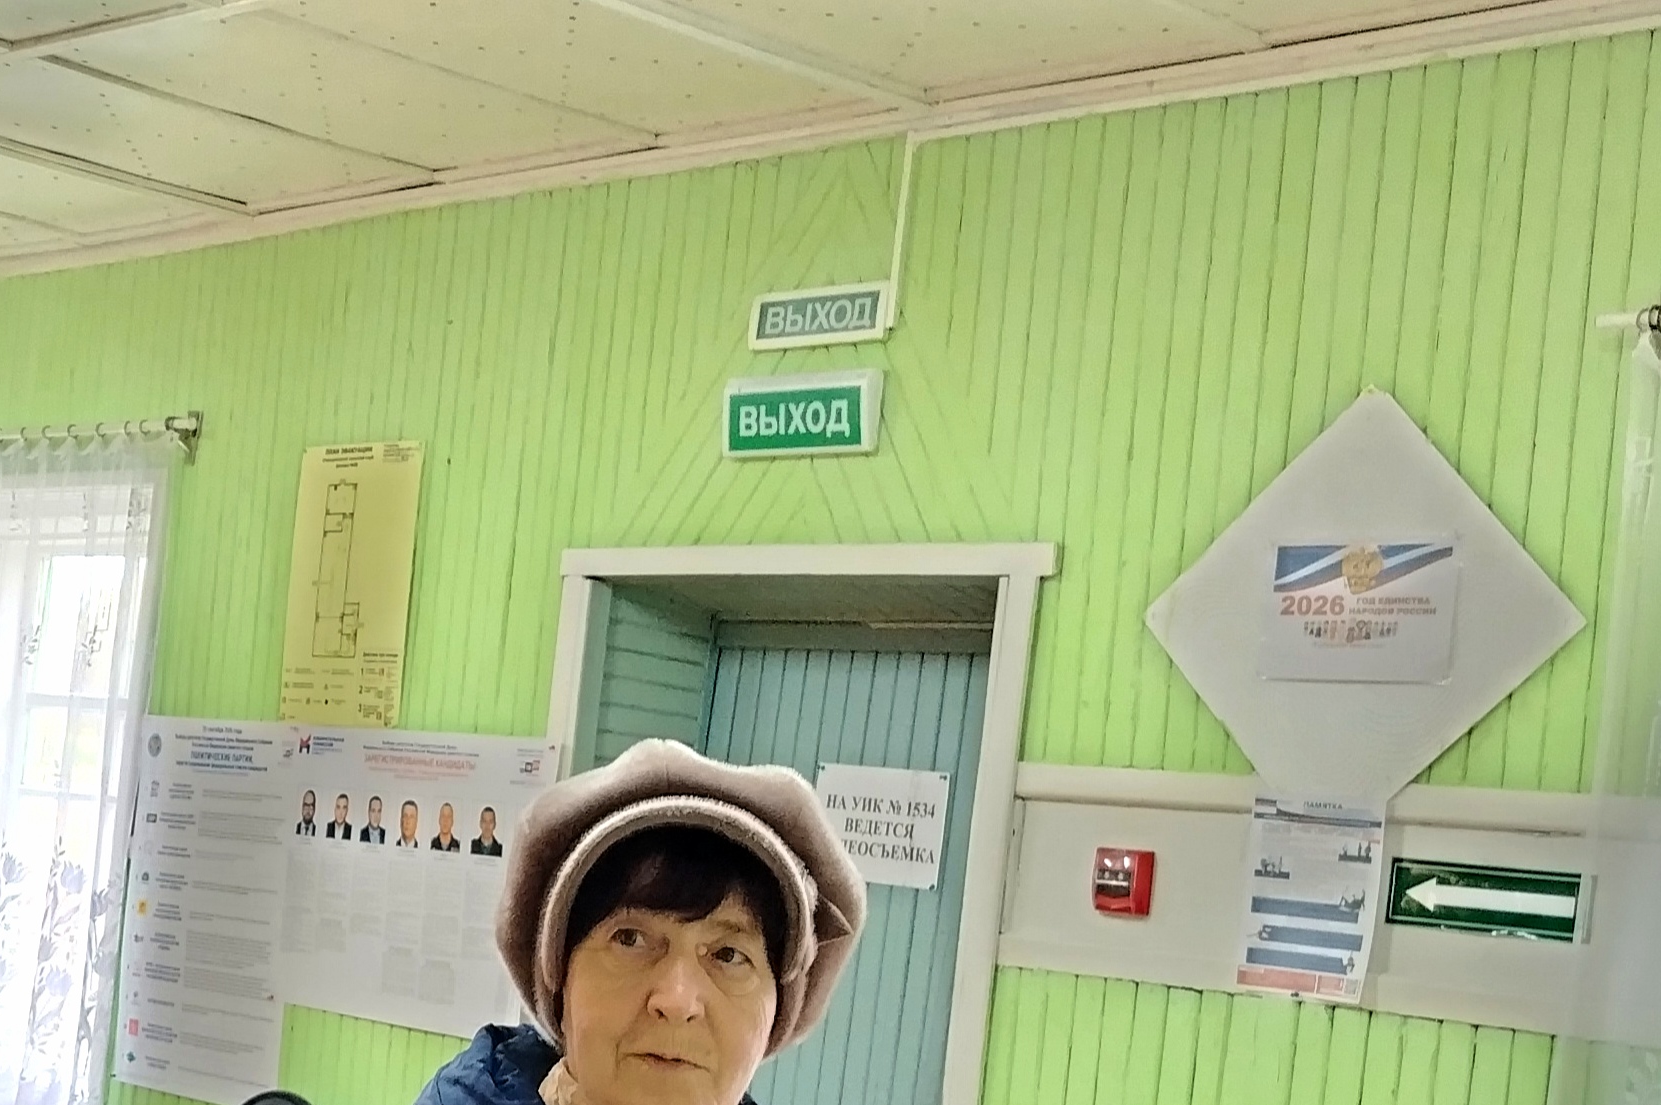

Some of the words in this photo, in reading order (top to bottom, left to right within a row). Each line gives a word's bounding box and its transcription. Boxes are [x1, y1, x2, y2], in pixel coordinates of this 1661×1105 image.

[764, 297, 872, 335] ВЫХОД
[739, 398, 851, 438] ВЫХОД
[1280, 594, 1345, 616] 2026
[1355, 596, 1374, 605] ГОД
[1377, 596, 1431, 606] ЕДИНСТВА
[1396, 606, 1437, 616] РОССИИ
[826, 794, 847, 810] НА
[852, 796, 884, 814] УИК
[886, 799, 902, 815] №
[906, 801, 936, 819] 1534
[844, 817, 915, 839] ВЕДЕТСЯ
[841, 838, 935, 864] ЕОСЪЕМКА
